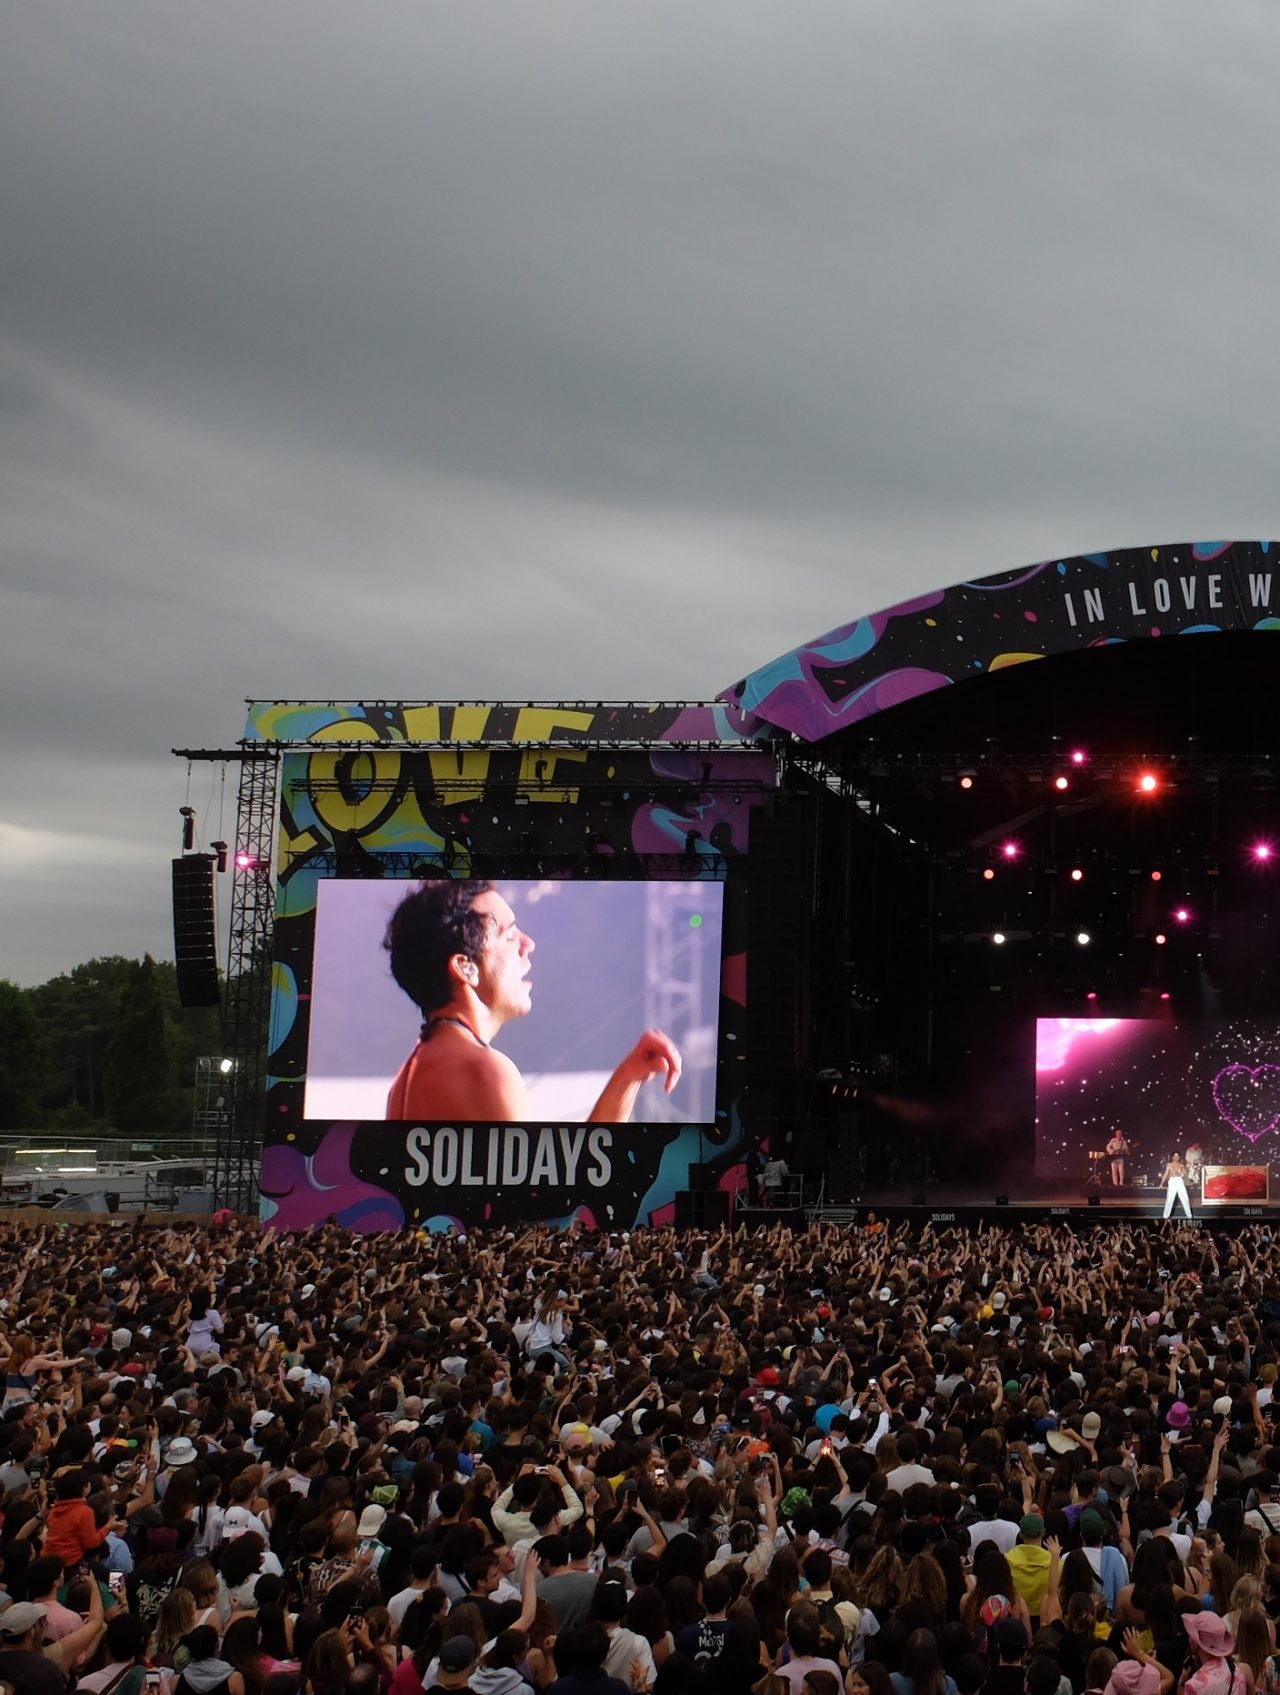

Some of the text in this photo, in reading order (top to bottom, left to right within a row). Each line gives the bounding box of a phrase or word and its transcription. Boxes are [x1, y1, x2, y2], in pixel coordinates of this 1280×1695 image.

[1064, 587, 1106, 627] IN
[1128, 573, 1224, 616] LOVE
[404, 1127, 613, 1188] SOLIDAYS
